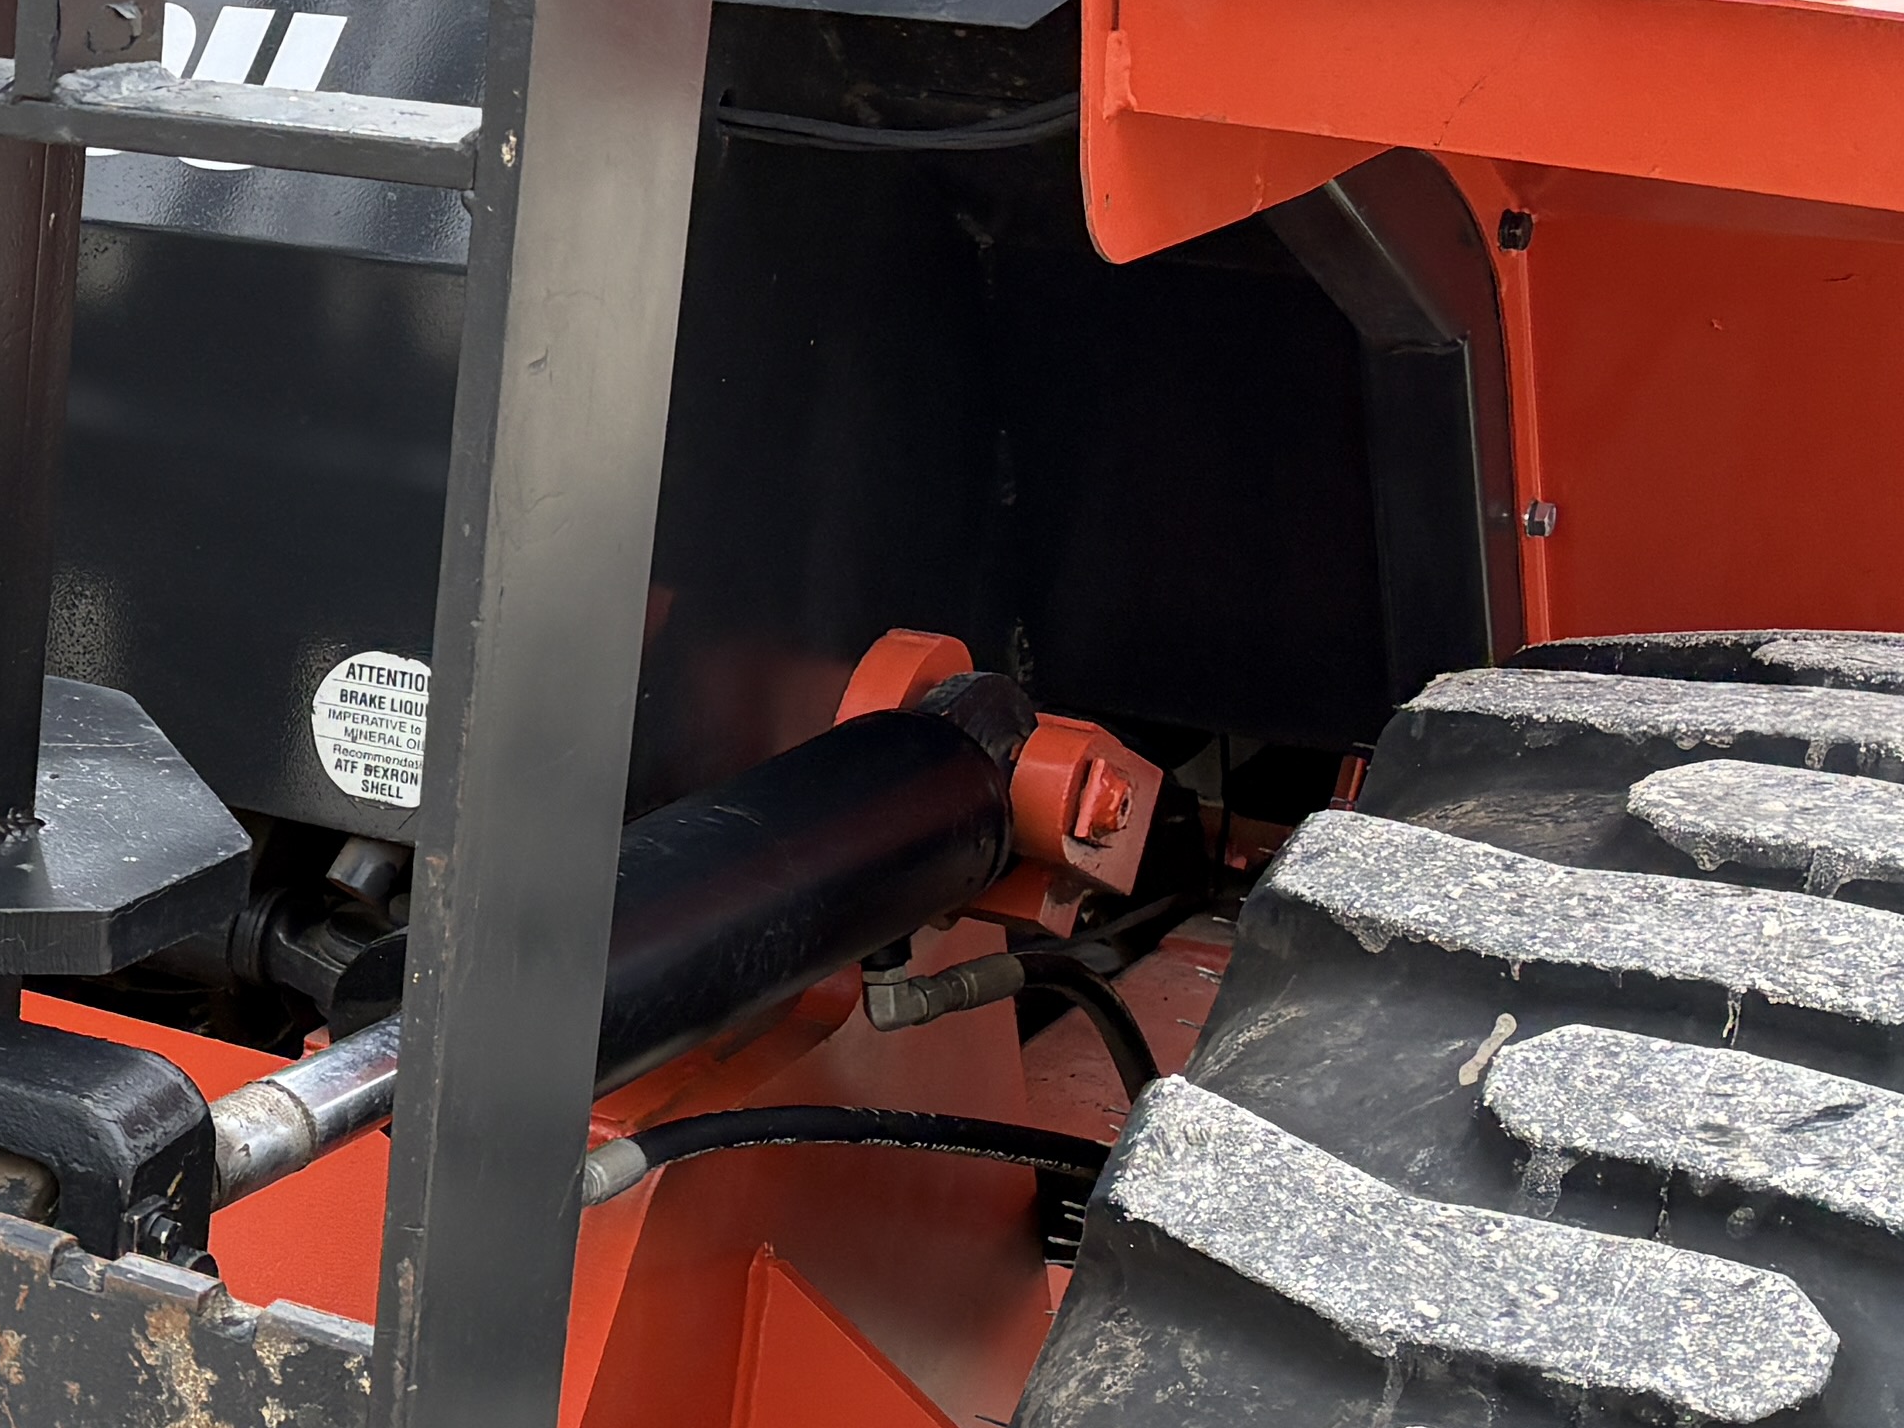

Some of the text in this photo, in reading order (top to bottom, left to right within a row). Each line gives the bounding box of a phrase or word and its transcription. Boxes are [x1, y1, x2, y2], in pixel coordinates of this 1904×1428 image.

[345, 662, 431, 693] ATTENTIO
[339, 688, 386, 710] BRAKE
[328, 708, 422, 736] IMPERATIVE to
[344, 726, 402, 748] MINERAL
[334, 758, 359, 774] ATF
[361, 779, 404, 800] SHELL
